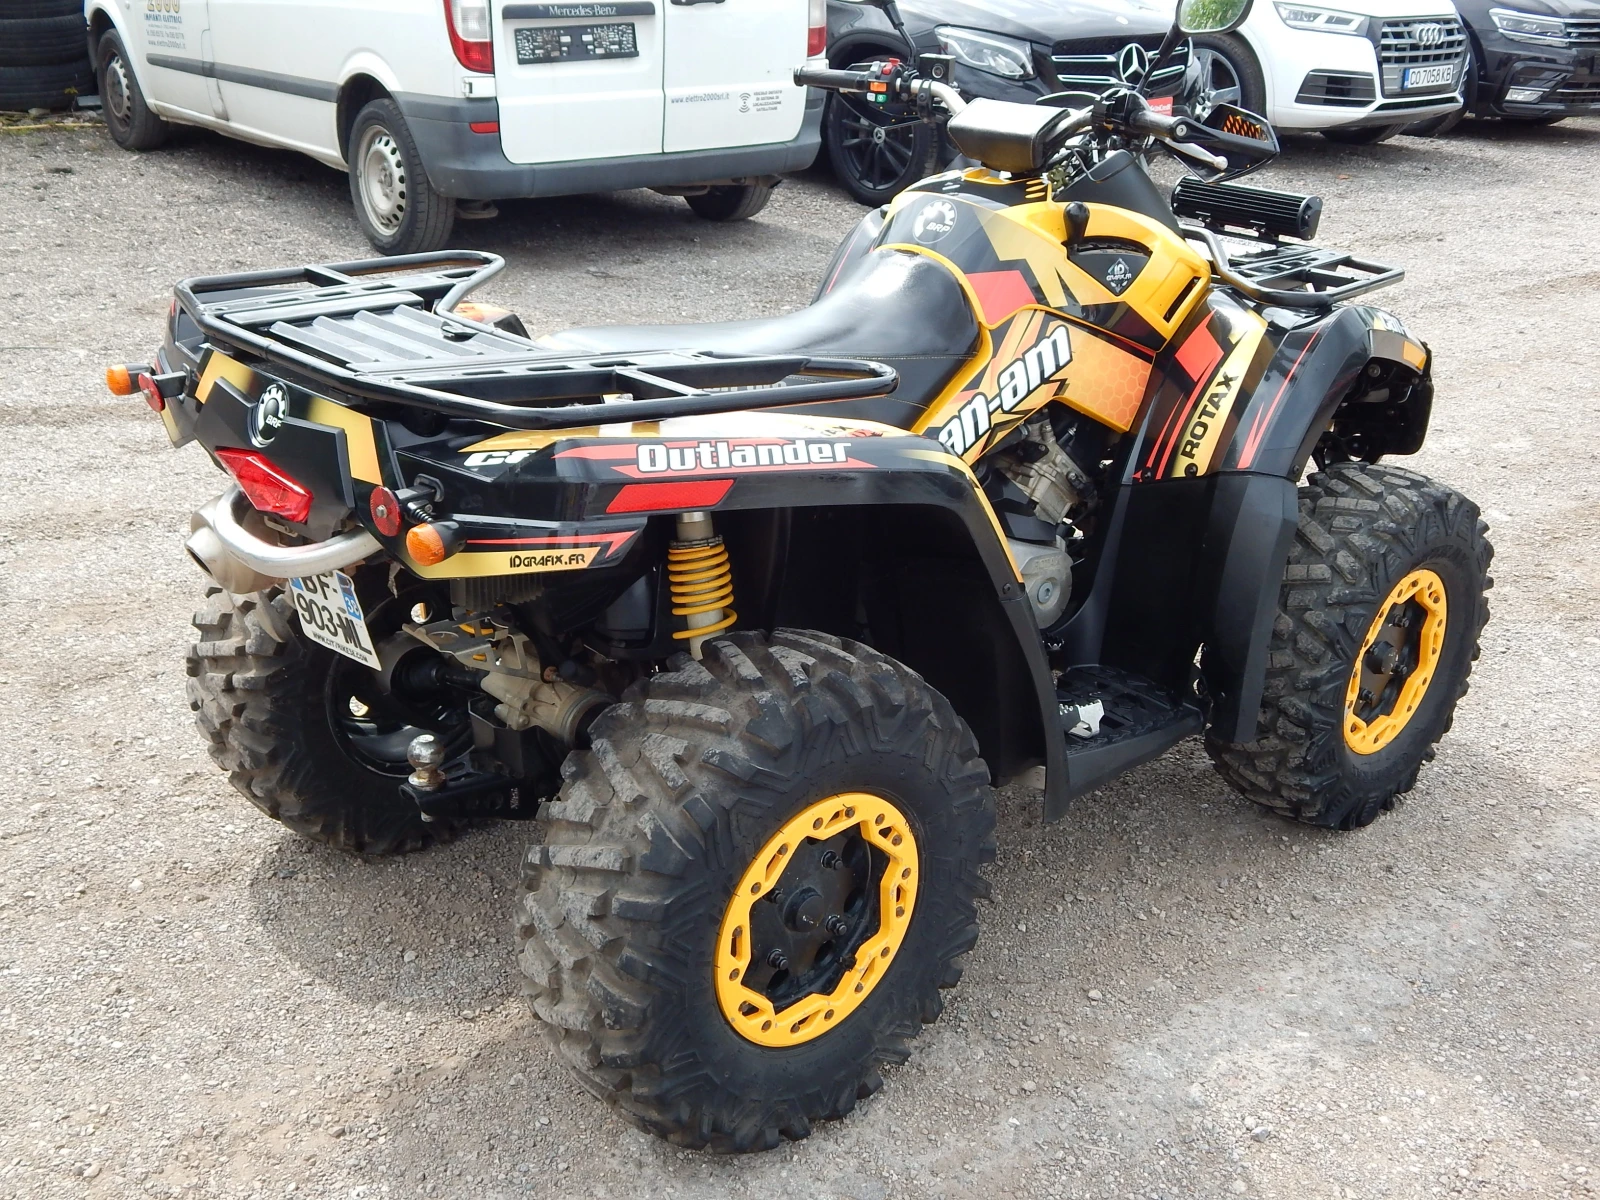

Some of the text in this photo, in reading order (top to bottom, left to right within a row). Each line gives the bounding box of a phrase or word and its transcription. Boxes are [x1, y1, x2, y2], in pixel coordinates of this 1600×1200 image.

[549, 5, 617, 16] Mercedes-Benz
[671, 92, 730, 104] www.elettro2000srl.it
[926, 221, 951, 233] BRP
[1180, 371, 1240, 460] ROTAX
[637, 440, 852, 473] Outlander
